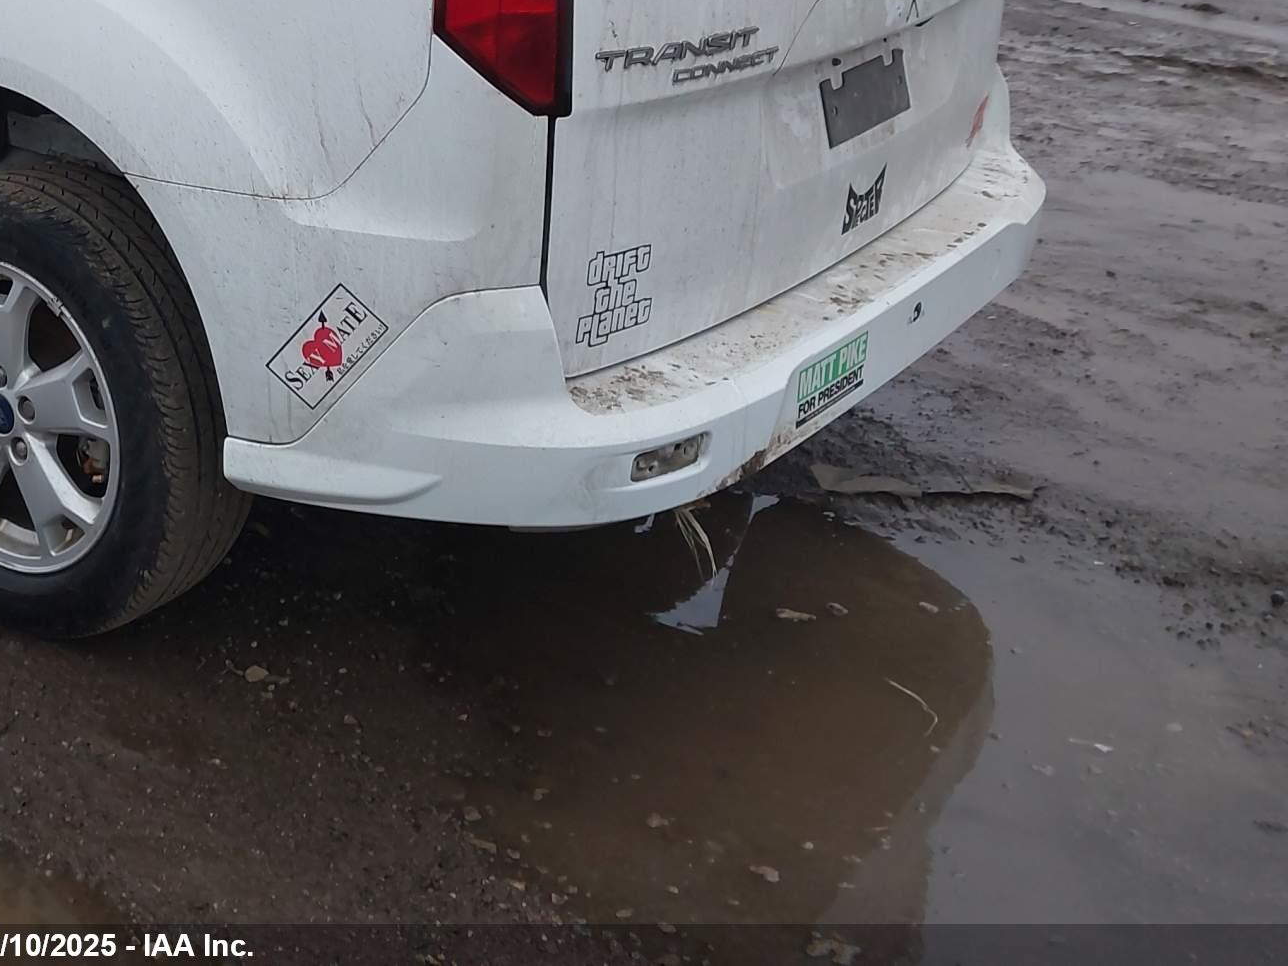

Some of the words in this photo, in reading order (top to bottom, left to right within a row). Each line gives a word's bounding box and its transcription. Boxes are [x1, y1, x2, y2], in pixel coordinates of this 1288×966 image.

[594, 25, 760, 73] TRANSIT
[671, 45, 780, 85] CONNECT
[323, 301, 368, 354] MATE
[797, 396, 817, 419] FOR
[817, 363, 865, 407] PRESIDENT
[798, 354, 837, 400] MATT
[838, 335, 868, 376] PIKE
